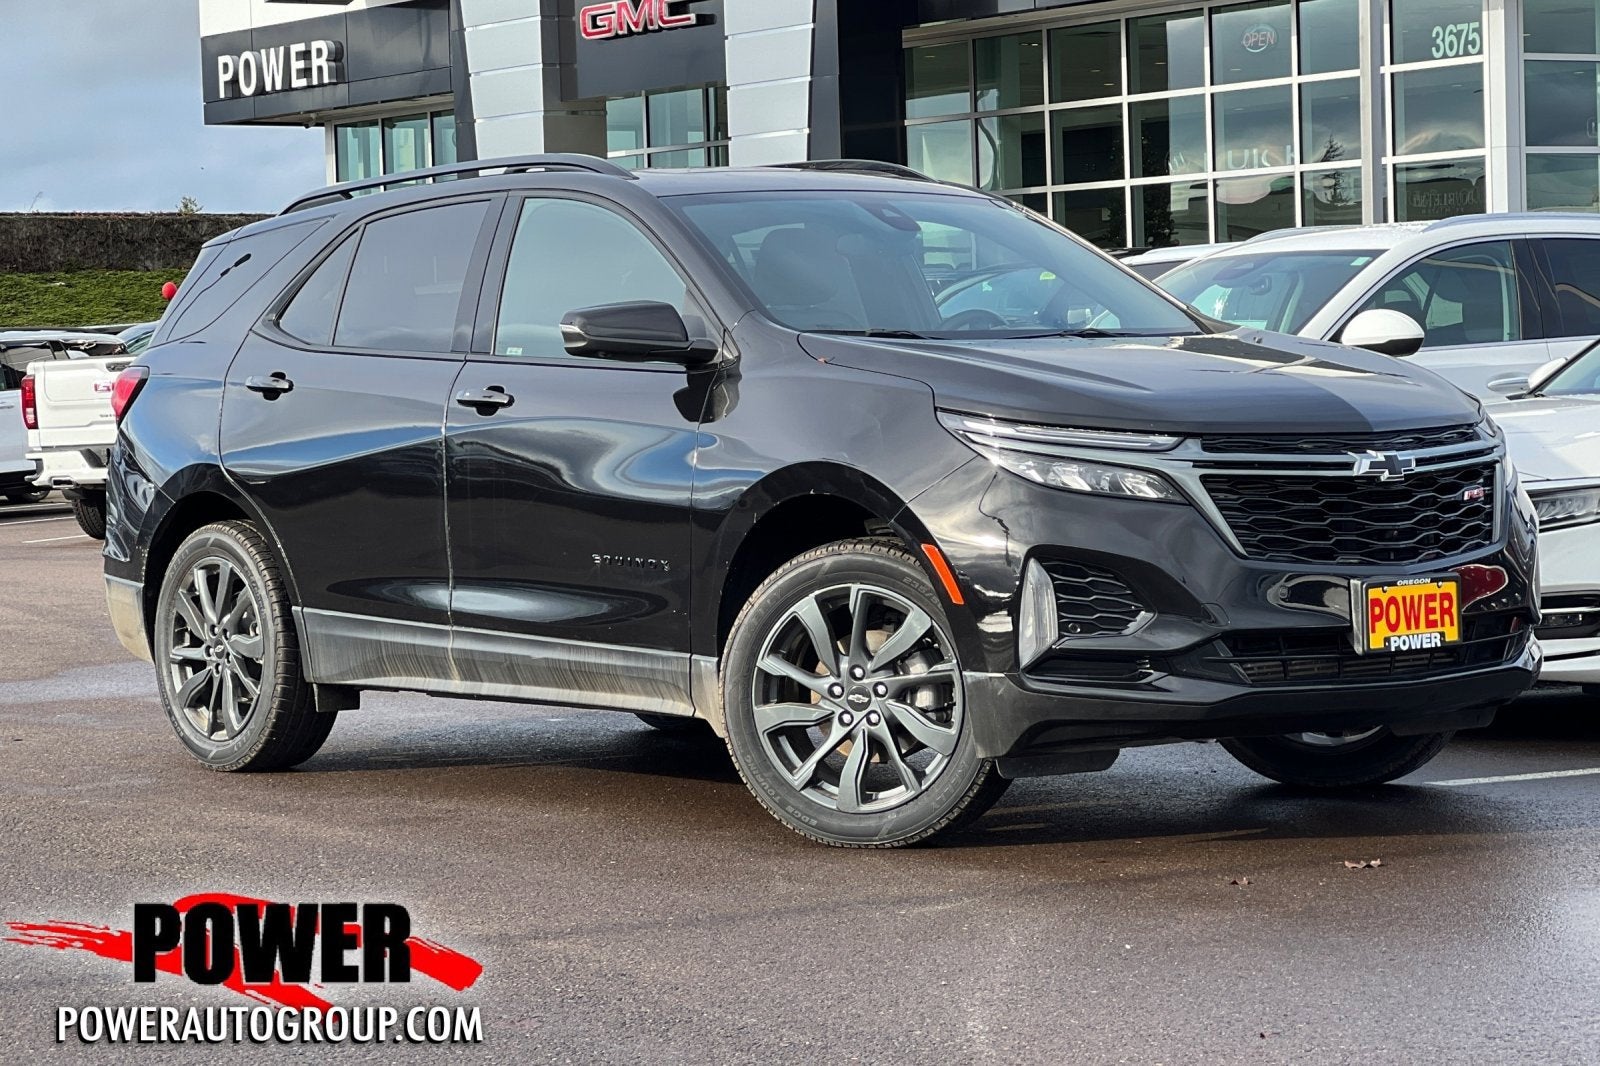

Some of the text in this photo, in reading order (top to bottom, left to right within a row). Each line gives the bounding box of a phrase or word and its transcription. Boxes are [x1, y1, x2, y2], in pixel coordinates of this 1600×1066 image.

[580, 0, 696, 39] GMC
[1243, 31, 1276, 47] OPEN
[1432, 21, 1480, 58] 3675
[218, 40, 330, 98] POWER
[591, 553, 671, 572] EQUINOX
[1396, 578, 1431, 587] OREGON
[1370, 592, 1455, 633] POWER
[1390, 632, 1441, 652] POWER
[744, 754, 782, 804] TOURING
